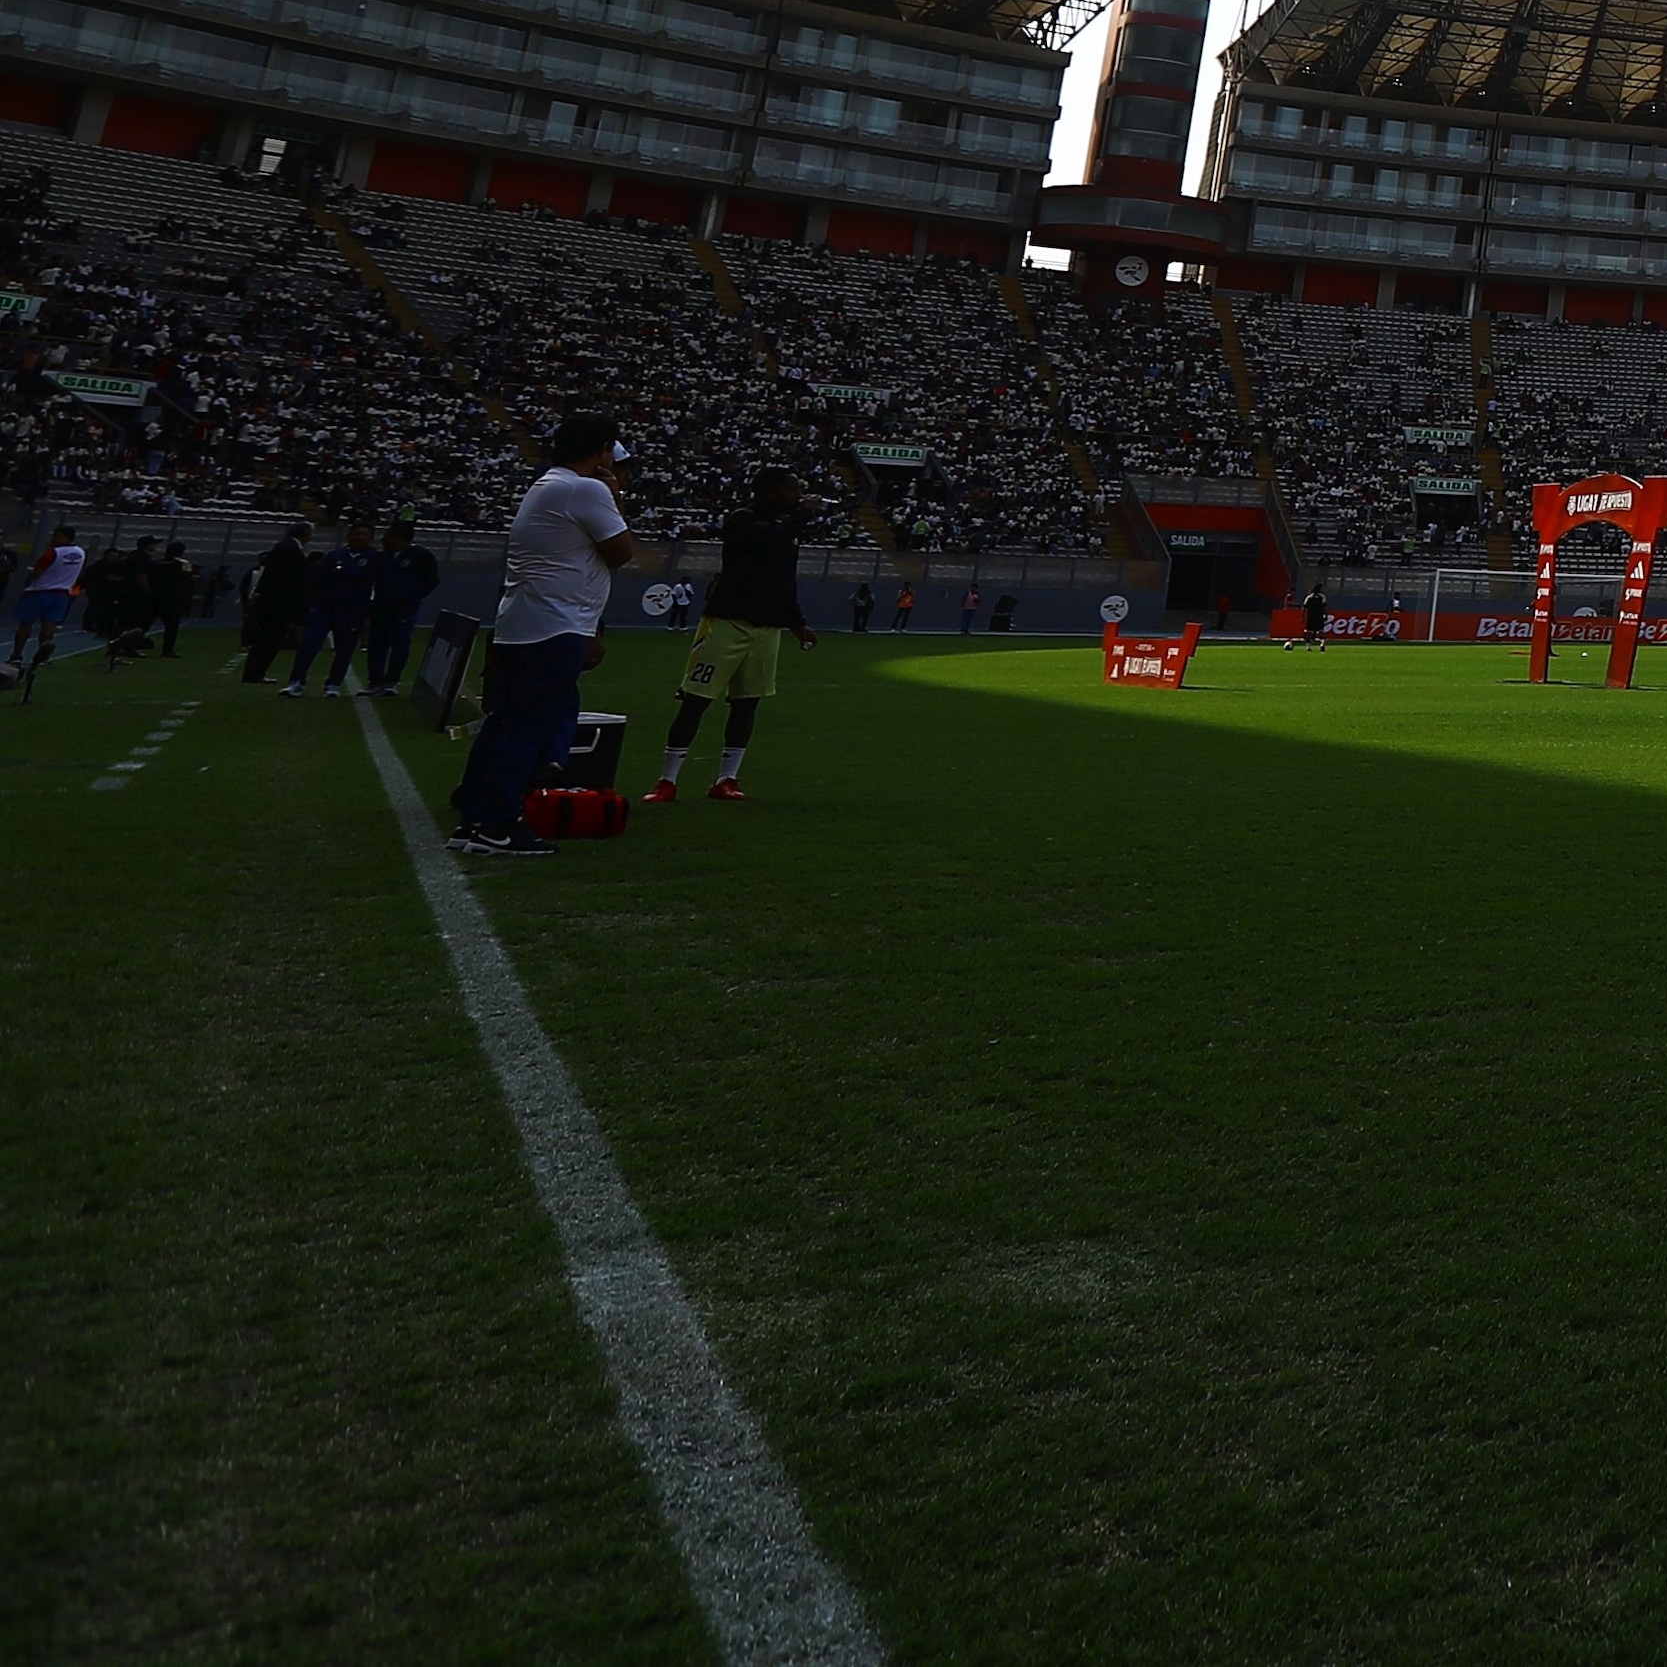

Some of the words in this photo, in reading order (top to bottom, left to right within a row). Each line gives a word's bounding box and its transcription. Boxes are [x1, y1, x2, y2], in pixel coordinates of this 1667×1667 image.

[64, 376, 133, 392] SALIDA
[1412, 430, 1464, 440] SALIDA
[858, 445, 921, 459] SALIDA
[1418, 480, 1471, 491] SALIDA
[1170, 534, 1205, 548] SALIDA
[691, 663, 715, 684] 28
